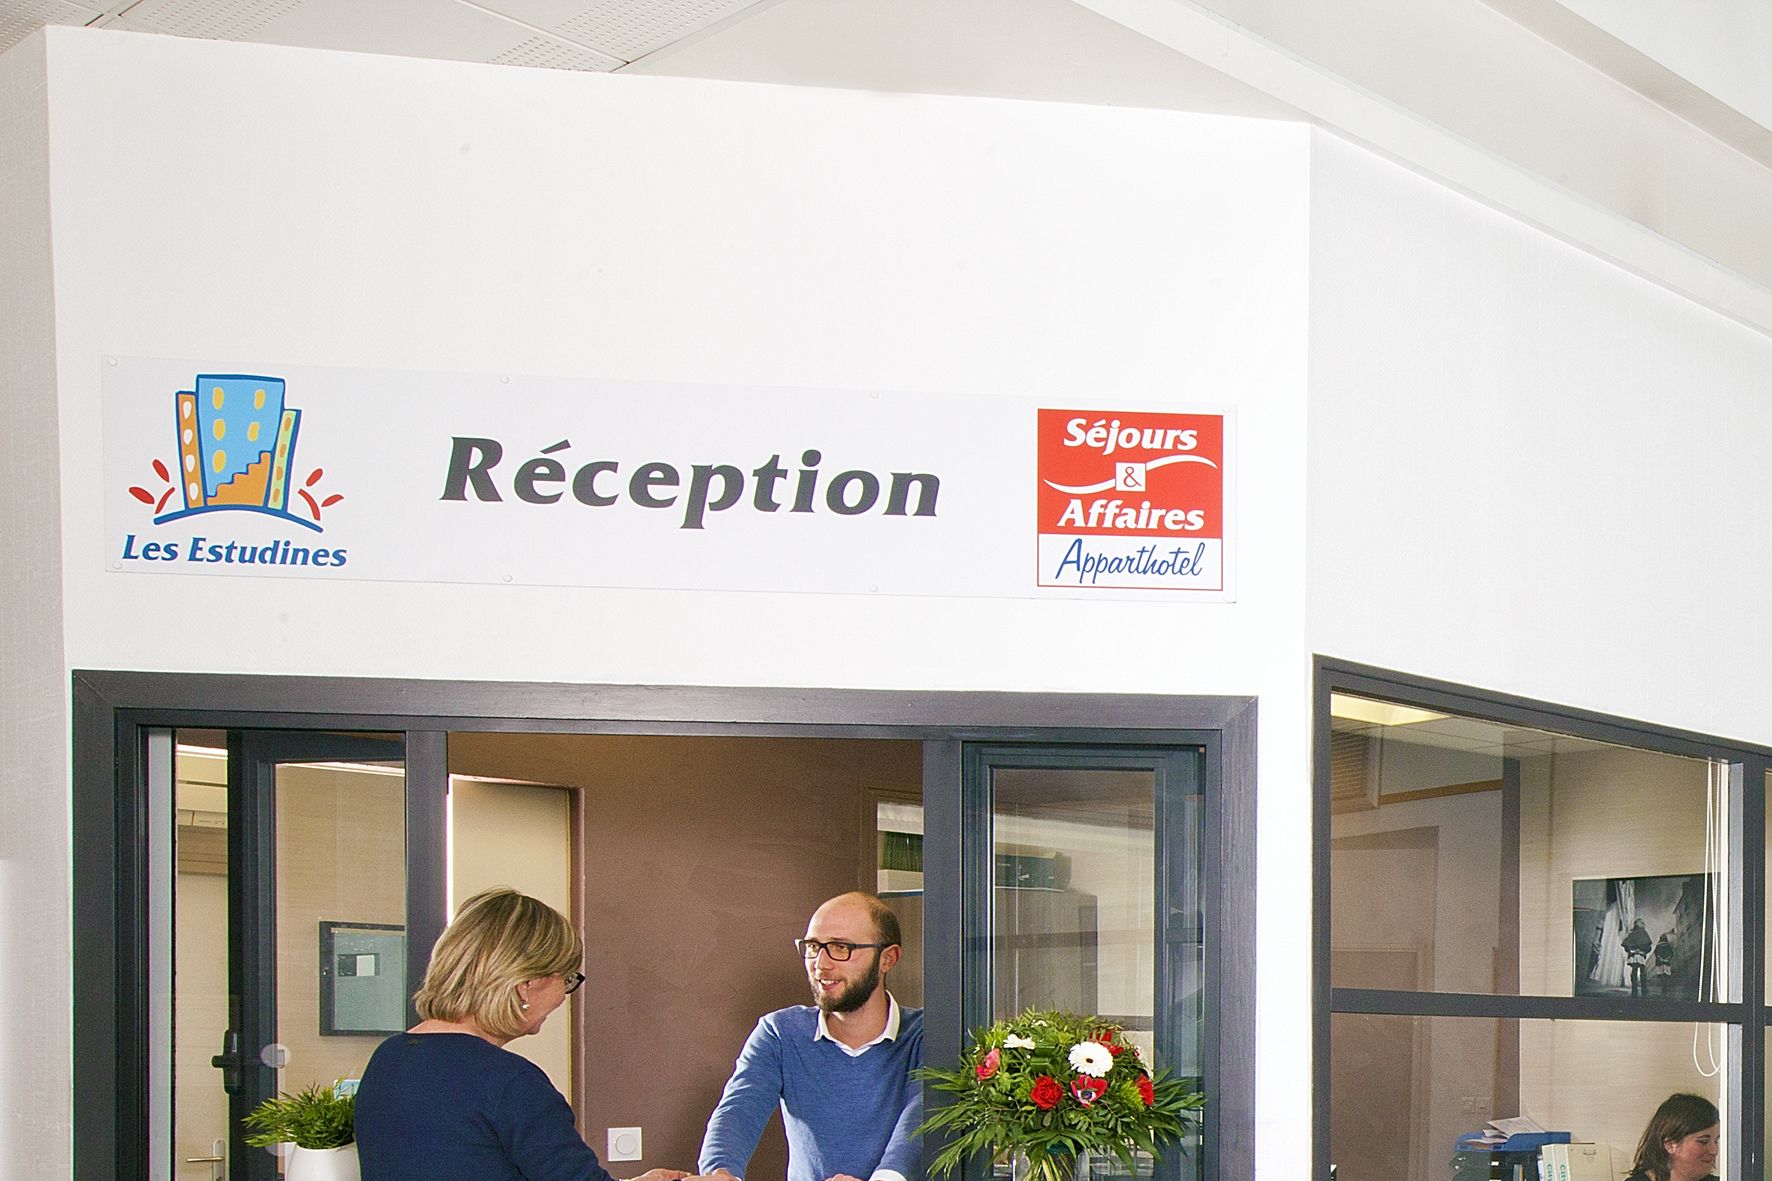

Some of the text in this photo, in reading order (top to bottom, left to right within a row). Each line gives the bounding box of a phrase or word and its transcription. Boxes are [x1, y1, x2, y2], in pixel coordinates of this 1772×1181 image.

[1063, 417, 1198, 456] Séjours
[438, 436, 941, 530] Réception
[1122, 465, 1143, 488] &
[1057, 498, 1205, 531] Affaires
[122, 534, 348, 567] Les Estudines
[1055, 538, 1206, 585] Apparthotel
